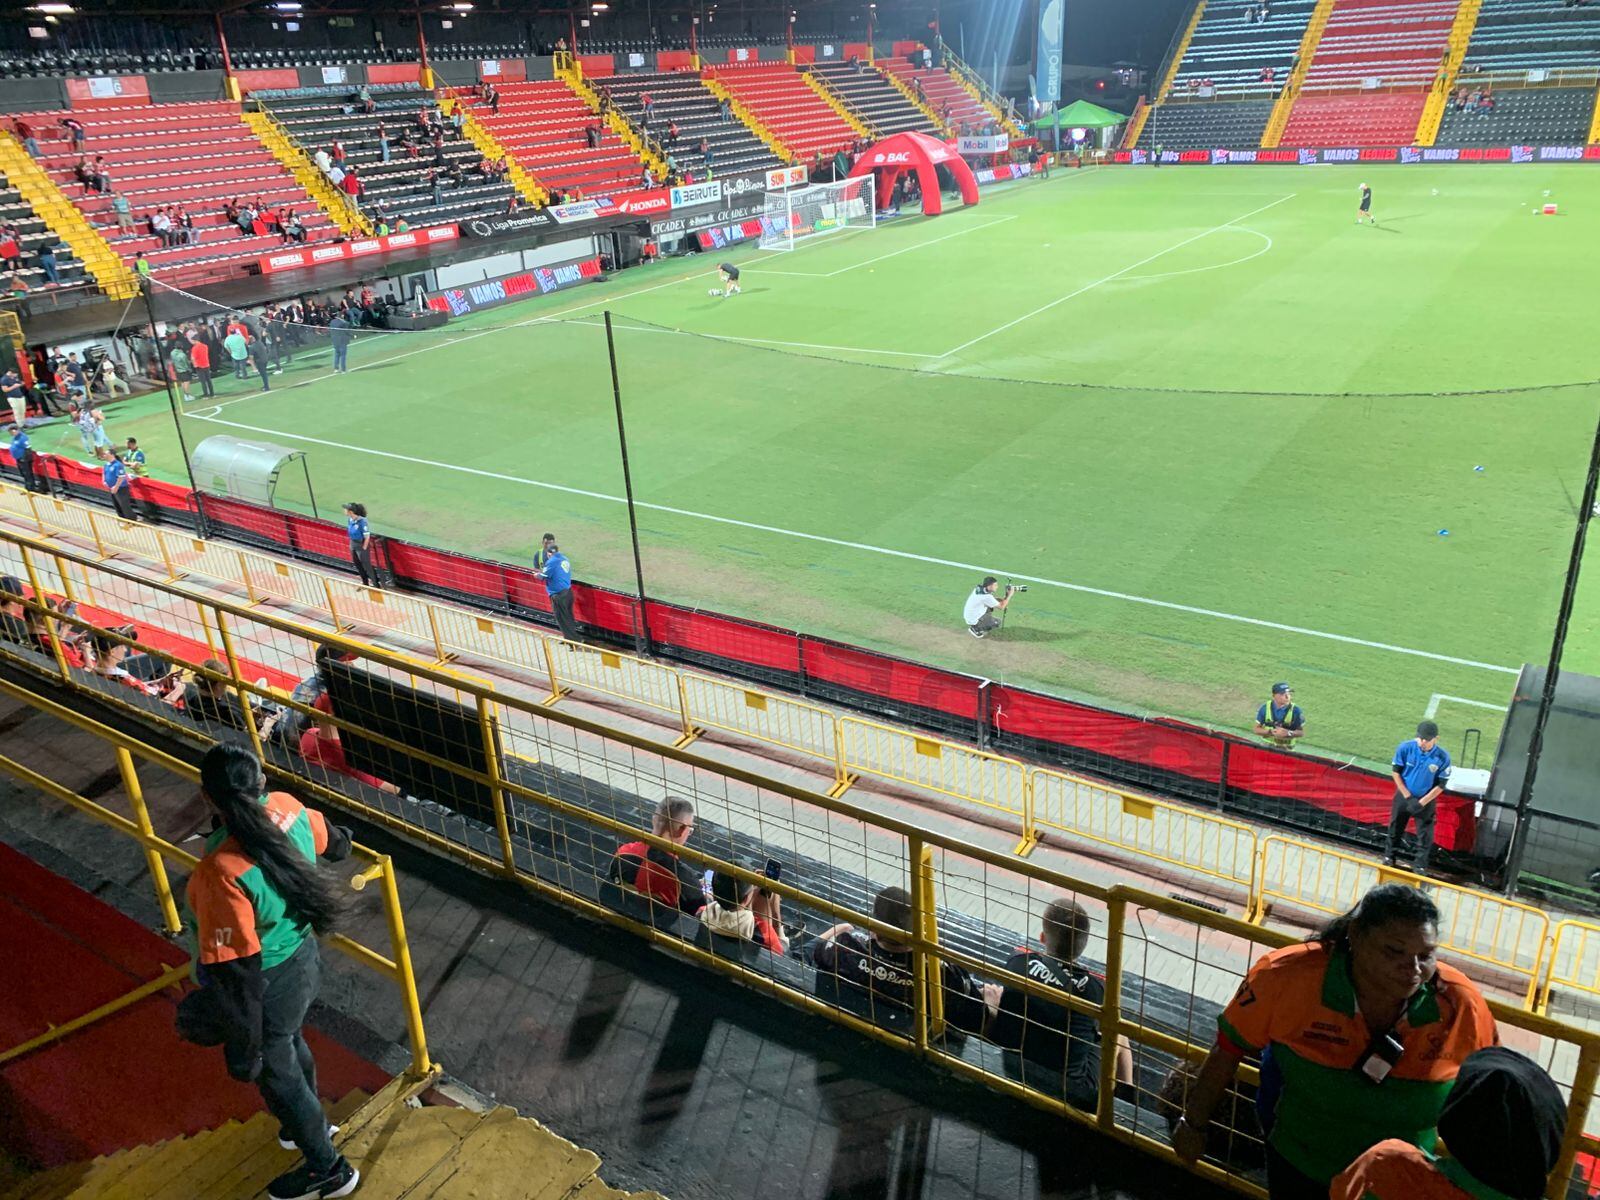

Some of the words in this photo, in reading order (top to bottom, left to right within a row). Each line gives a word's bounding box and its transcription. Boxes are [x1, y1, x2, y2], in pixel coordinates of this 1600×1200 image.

[1047, 54, 1059, 96] GRUPO
[113, 81, 122, 94] G
[963, 139, 989, 150] Mobil
[887, 151, 910, 162] BAC
[1151, 150, 1180, 162] VMOS
[1229, 150, 1257, 162] VAMOS
[1323, 148, 1359, 161] VAMOS
[1360, 148, 1398, 160] LEONES
[1423, 148, 1459, 161] VAMOS
[1540, 146, 1583, 160] VAMOS
[770, 172, 786, 187] SUR
[789, 168, 804, 183] SUR
[683, 185, 719, 202] BEIRUTE
[722, 179, 738, 195] Dos
[743, 178, 766, 191] Pinos
[629, 197, 667, 213] HONDA
[491, 220, 510, 231] Liga
[507, 214, 548, 227] Promerica
[652, 219, 686, 235] CICADEX
[553, 264, 582, 284] VAMOS
[469, 280, 506, 305] VAMOS
[502, 273, 537, 297] LEONES
[857, 958, 876, 977] Dos
